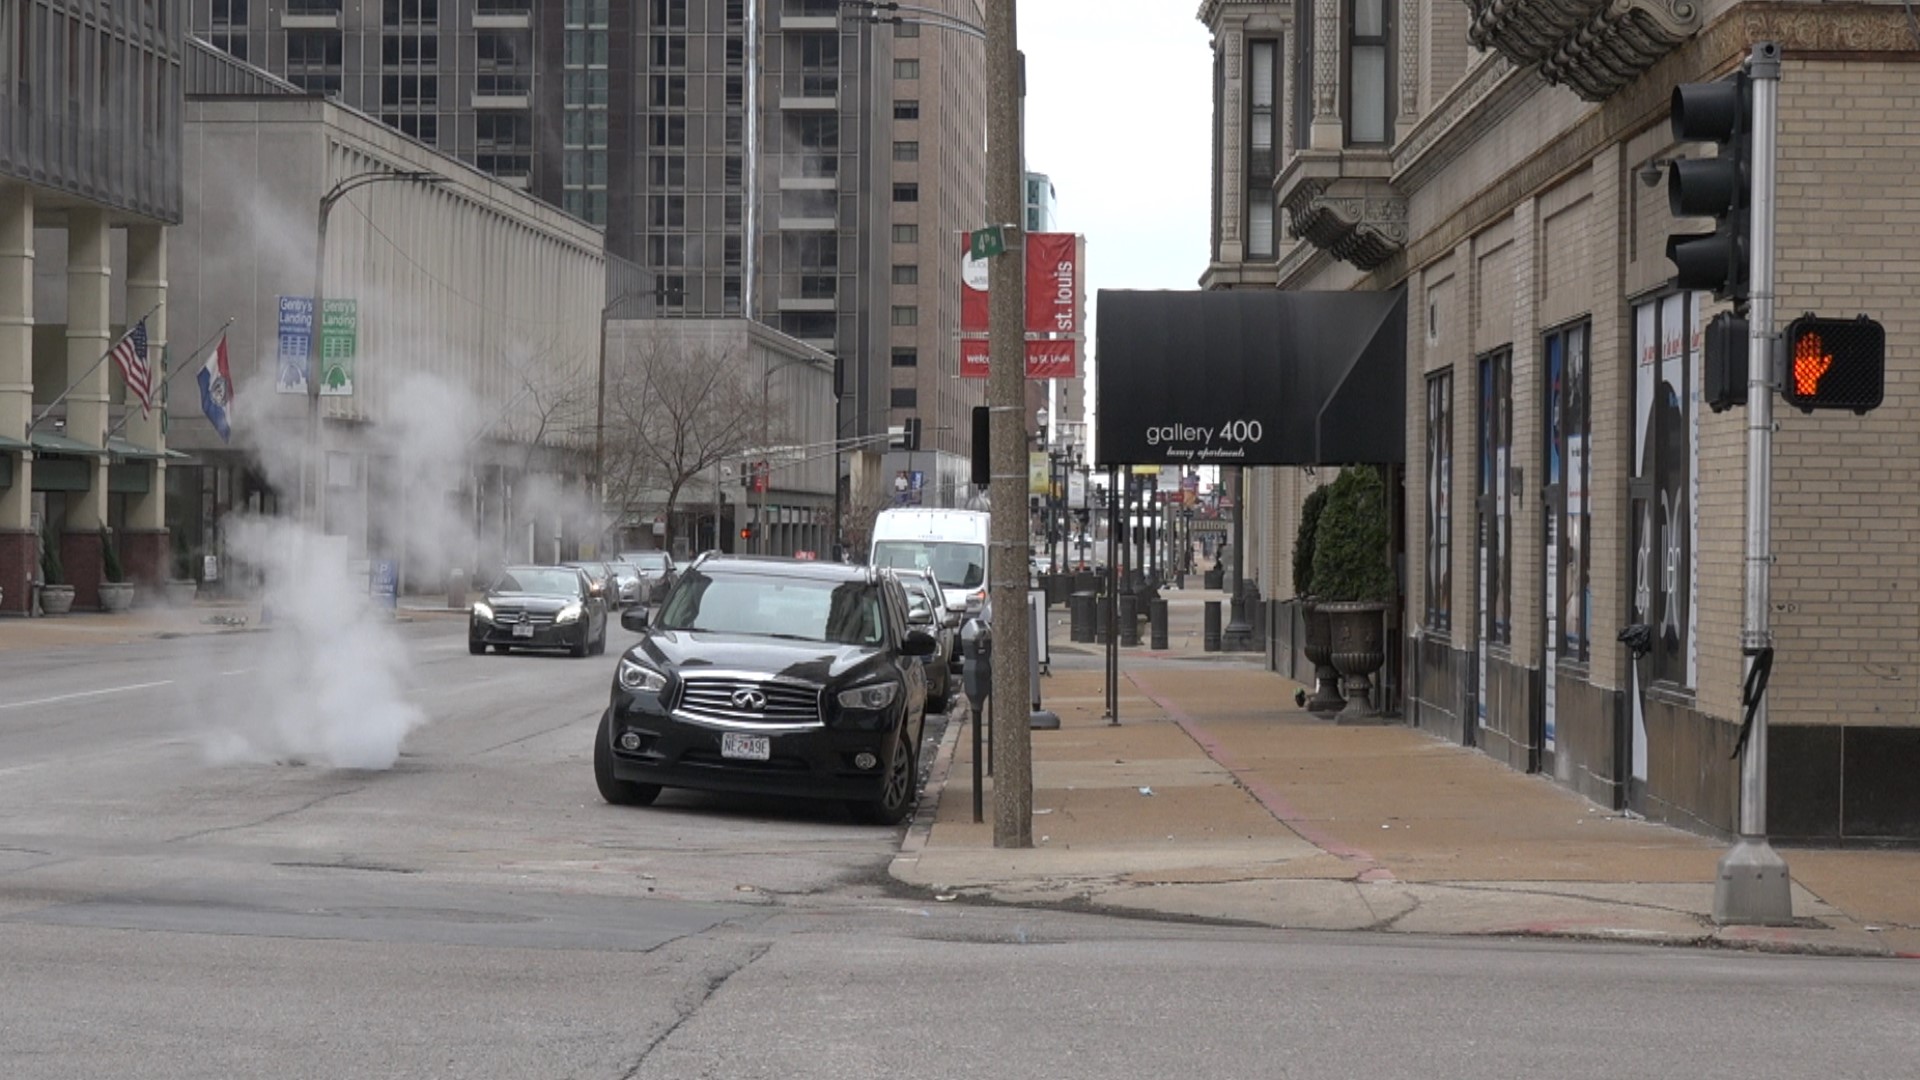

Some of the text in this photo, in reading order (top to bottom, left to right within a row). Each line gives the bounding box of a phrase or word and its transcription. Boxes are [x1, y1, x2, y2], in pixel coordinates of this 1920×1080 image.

[1054, 261, 1072, 331] st. louis
[281, 298, 313, 314] Gentry's
[323, 300, 356, 315] Gentry's
[280, 311, 312, 327] Landing
[322, 313, 355, 328] Landing
[1146, 420, 1263, 445] gallery 400
[1166, 446, 1245, 460] luxury apartments
